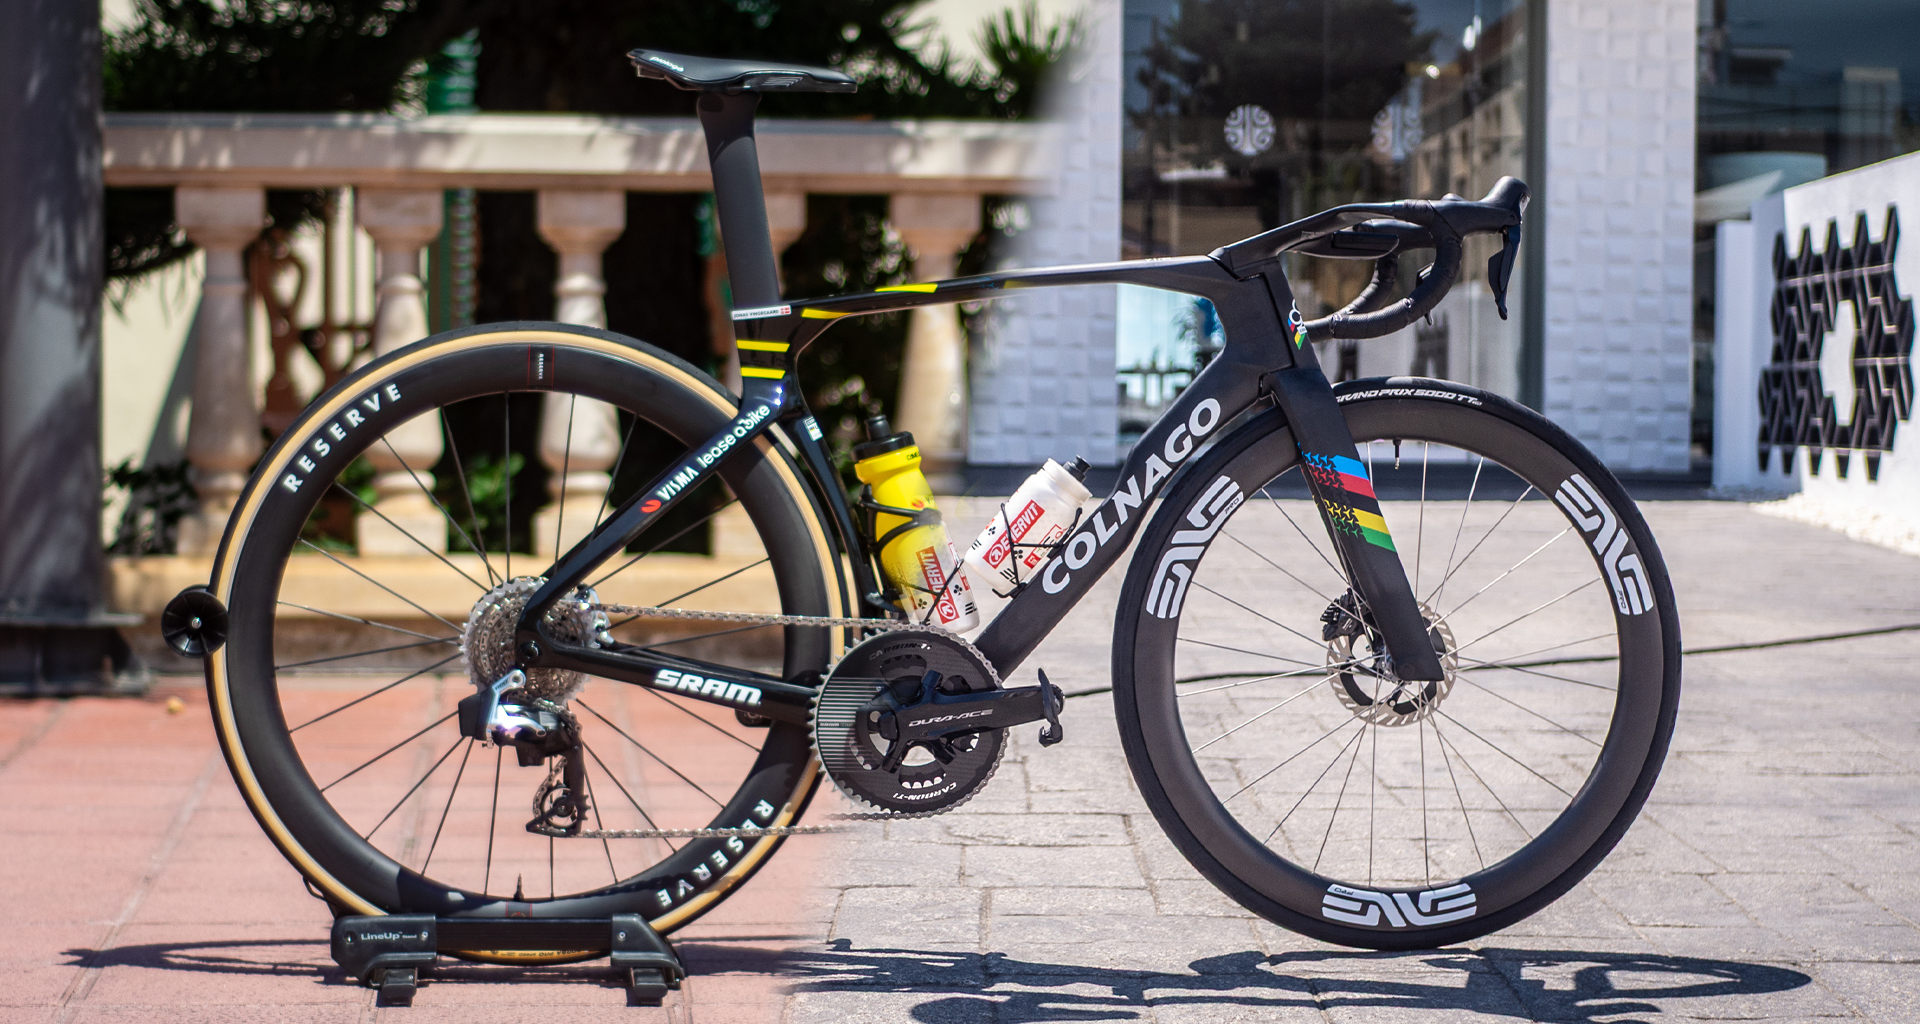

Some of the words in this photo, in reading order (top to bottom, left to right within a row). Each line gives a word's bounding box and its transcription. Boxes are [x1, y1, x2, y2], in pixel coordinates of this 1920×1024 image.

[1379, 388, 1415, 396] PRIX
[1413, 389, 1457, 399] 5000
[1457, 394, 1478, 404] TT
[283, 383, 401, 492] RESERVE
[656, 466, 700, 501] VISMA
[1042, 398, 1221, 594] COLNAGO
[655, 668, 762, 705] SRAM
[908, 709, 994, 727] DURA-ACE
[361, 932, 400, 941] LineUp
